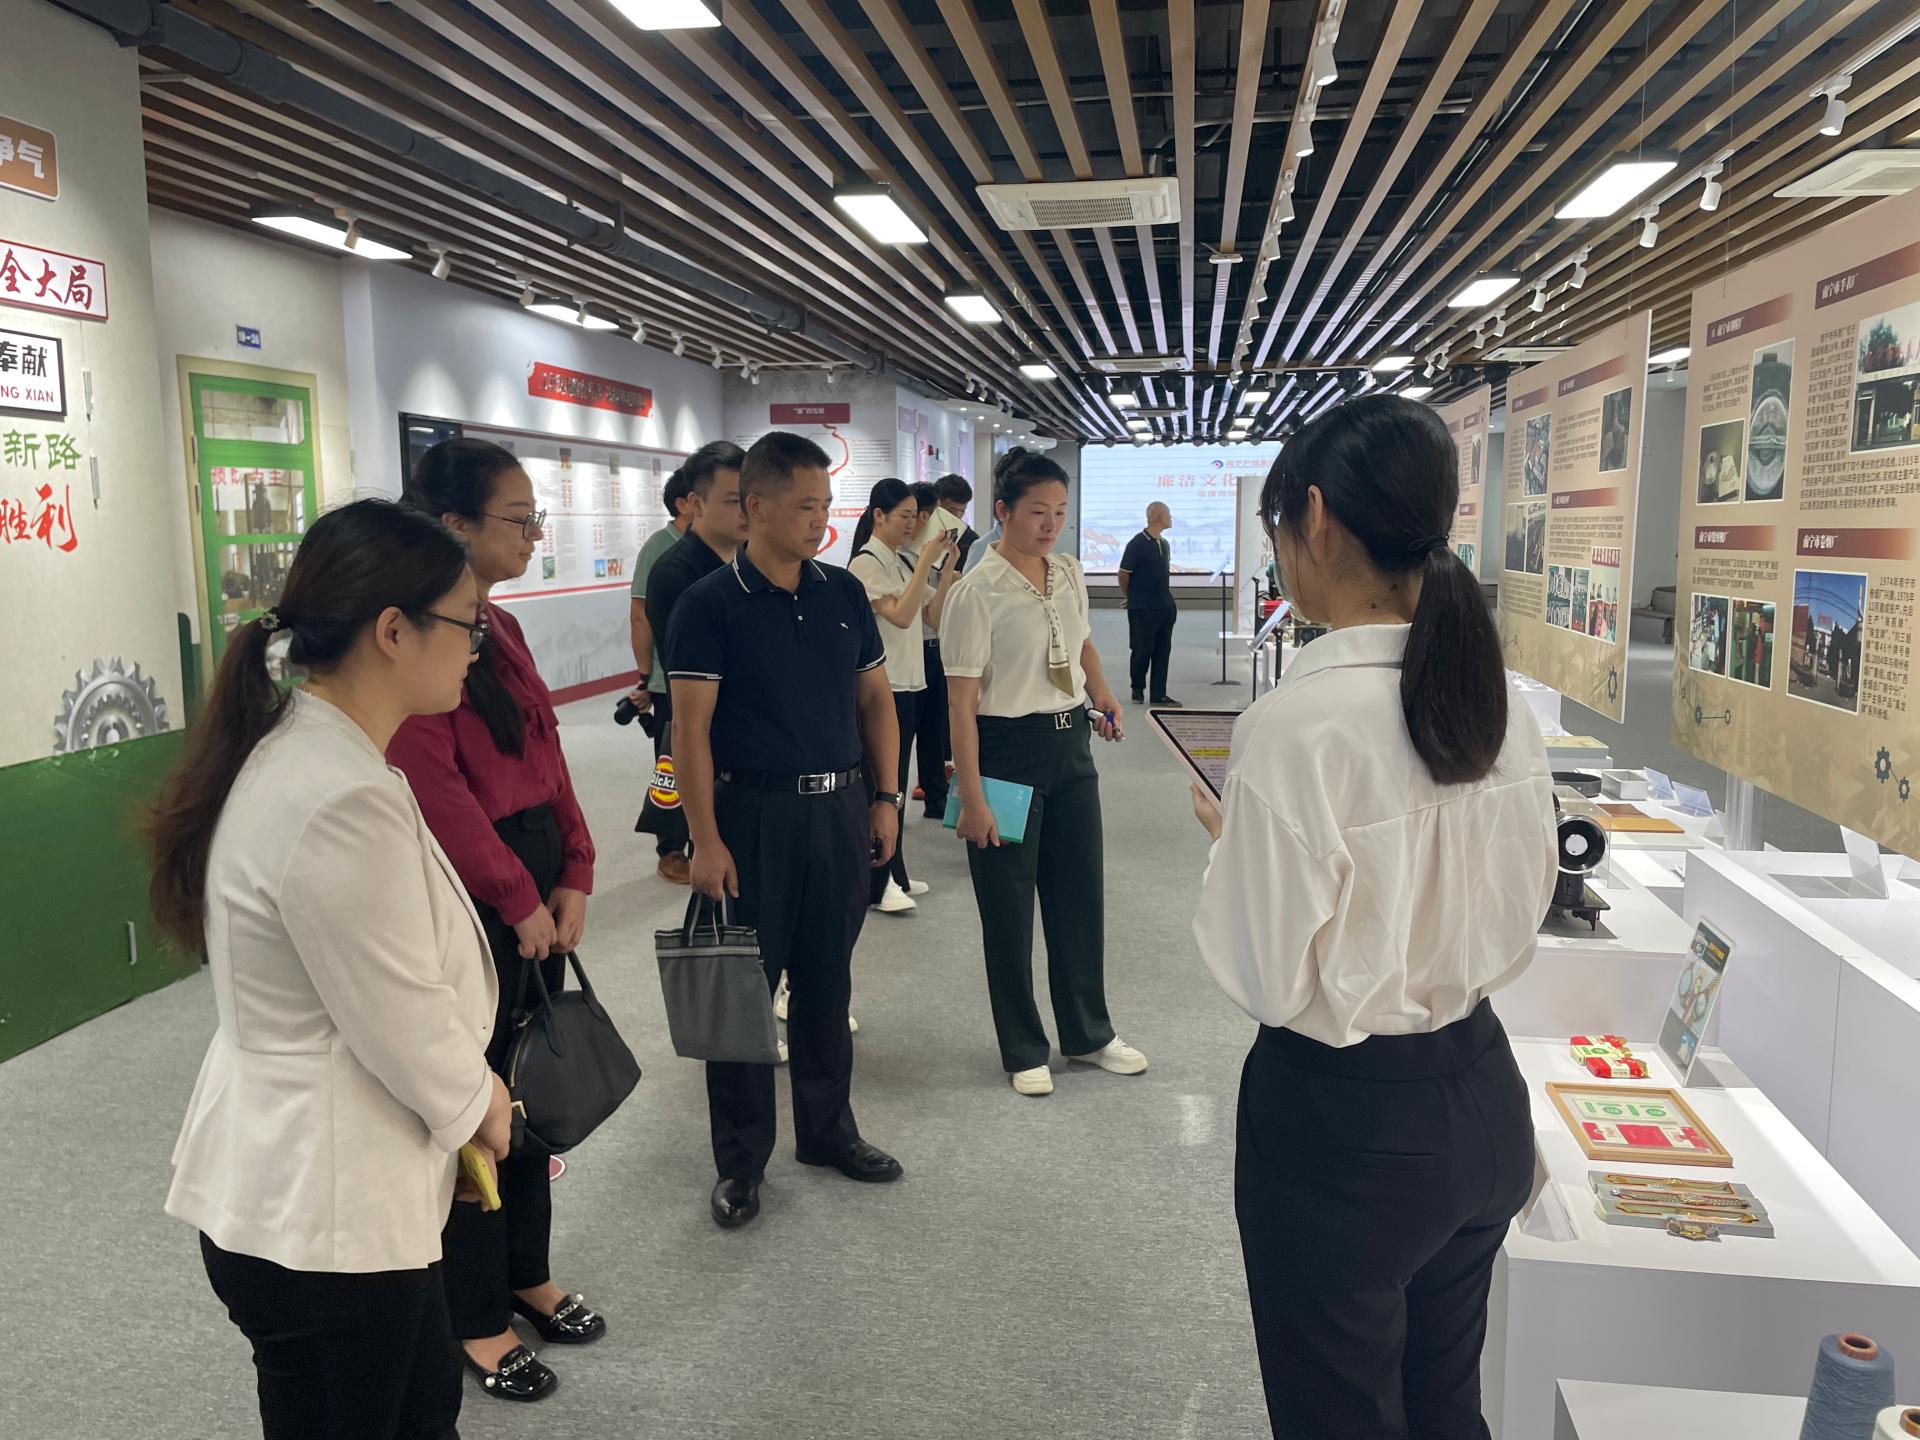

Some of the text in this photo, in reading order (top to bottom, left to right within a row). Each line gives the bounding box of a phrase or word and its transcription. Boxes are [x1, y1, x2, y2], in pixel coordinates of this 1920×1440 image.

[0, 248, 92, 310] 全大局
[26, 388, 54, 403] XIAN
[3, 429, 83, 470] 新路
[0, 483, 78, 552] 胜利
